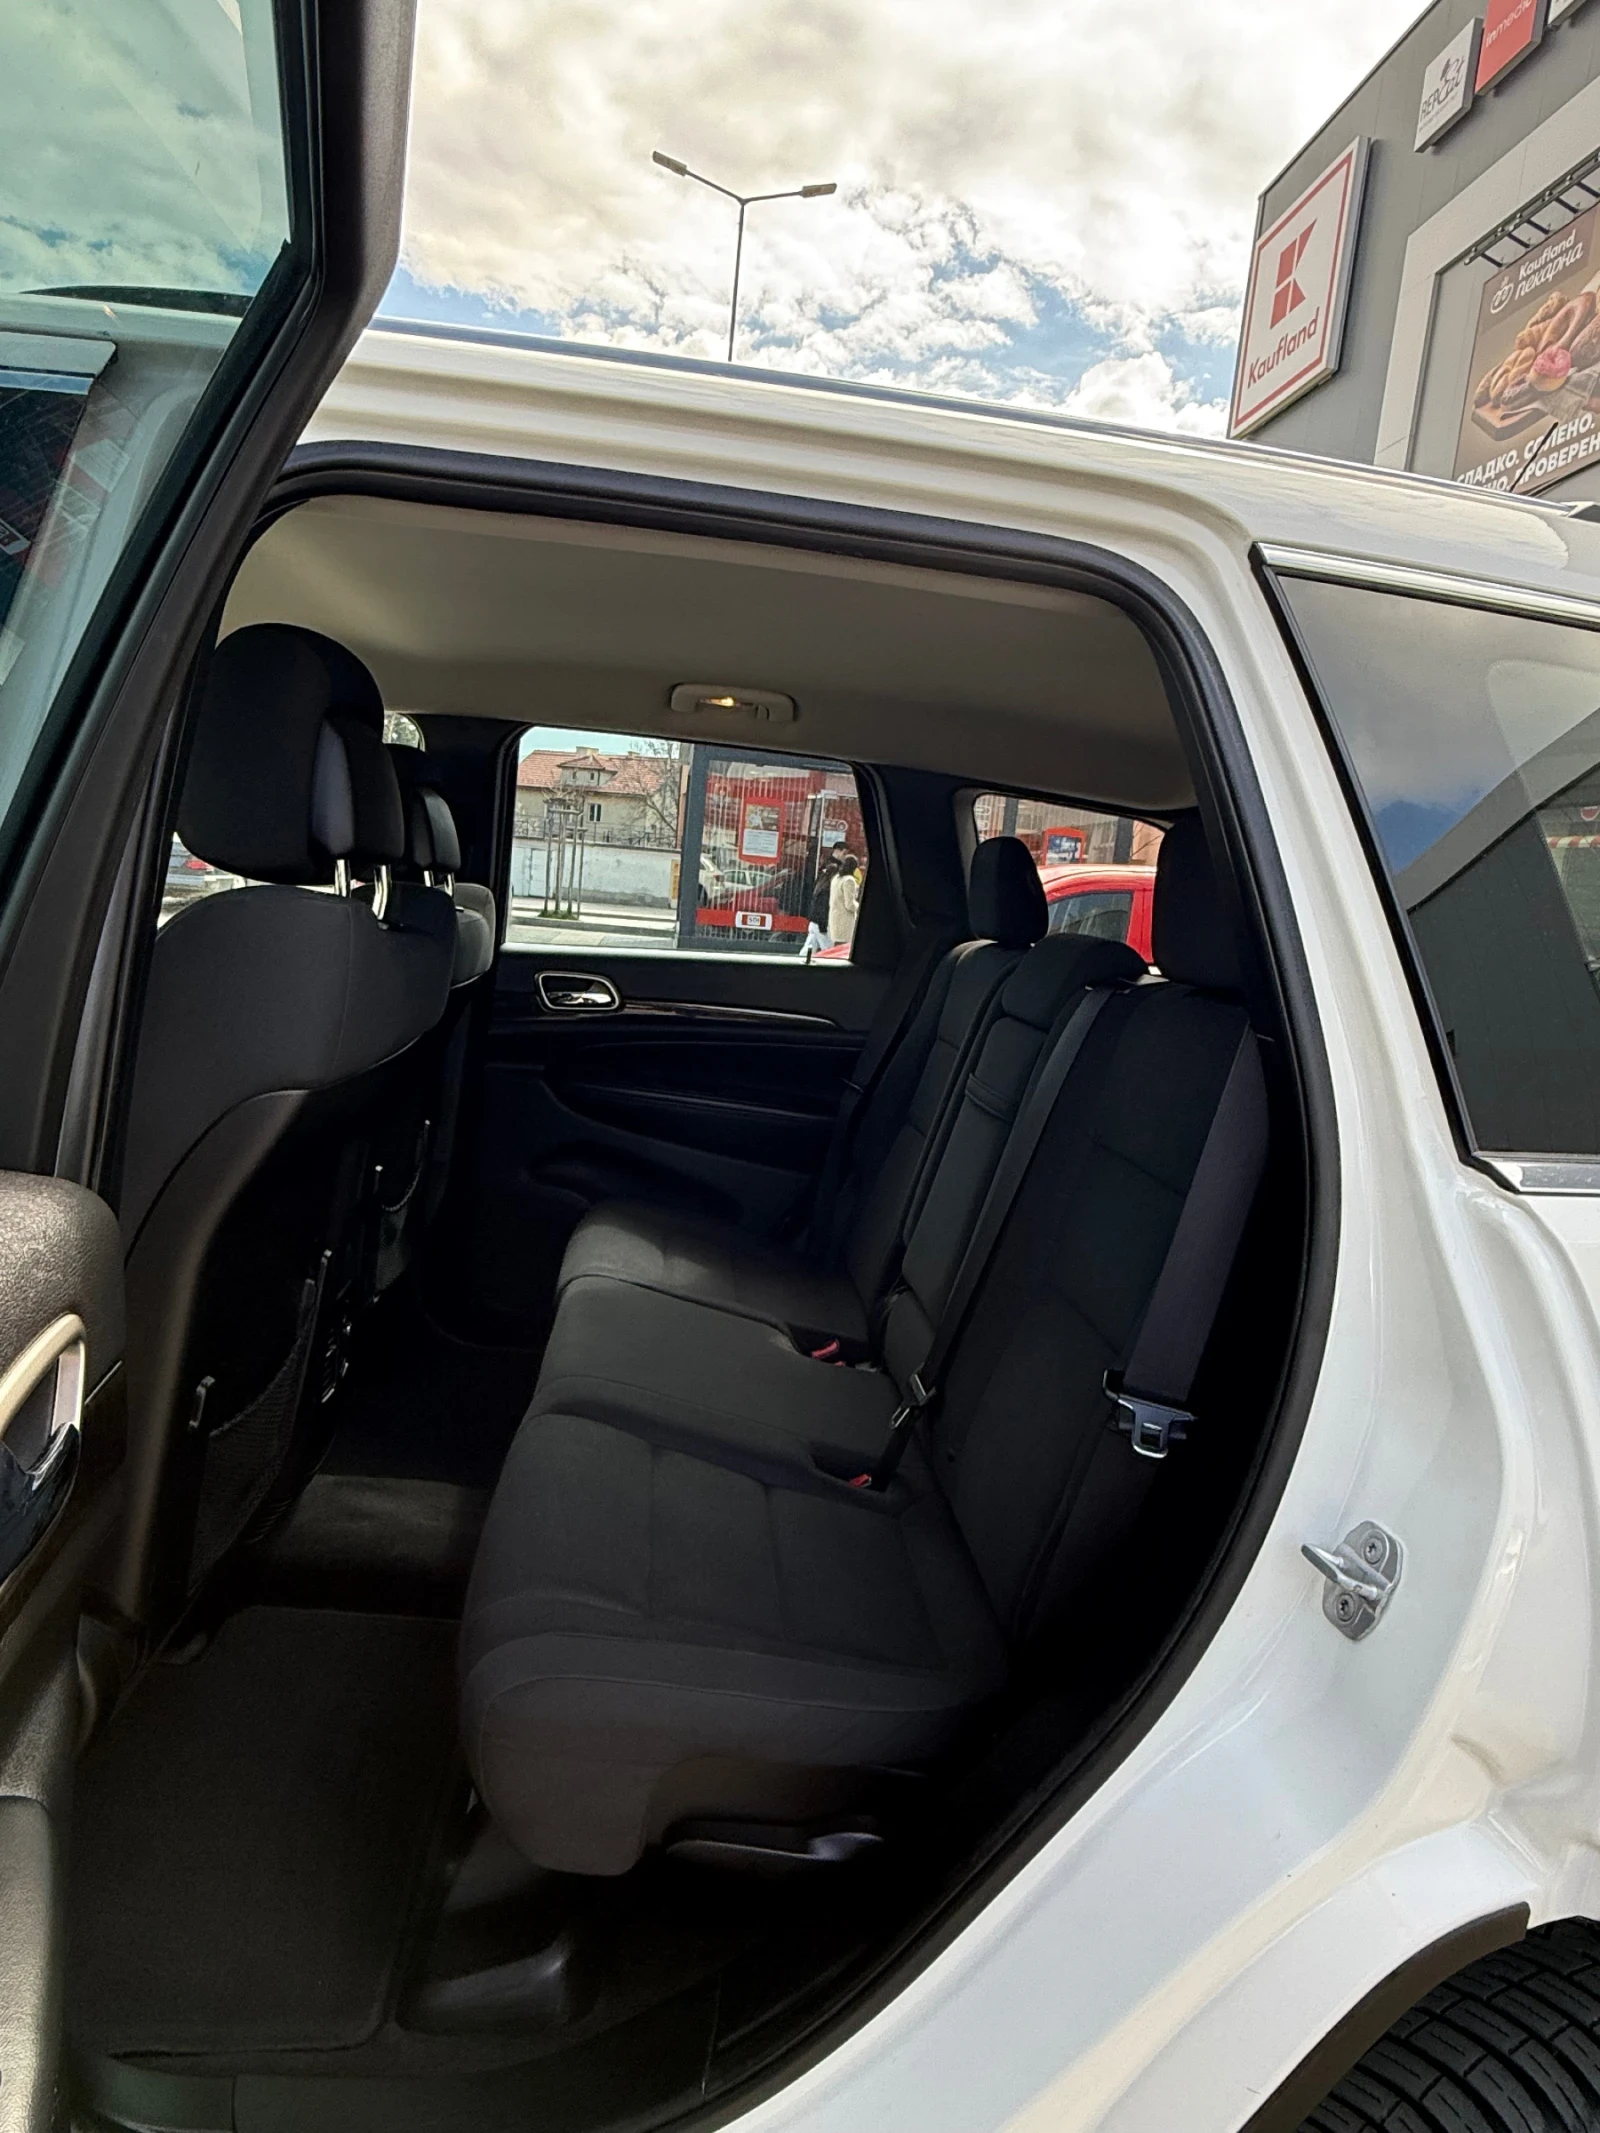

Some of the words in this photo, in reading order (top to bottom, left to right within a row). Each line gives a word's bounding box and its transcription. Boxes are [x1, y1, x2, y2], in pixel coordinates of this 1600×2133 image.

[1515, 242, 1583, 300] пекарна
[1519, 228, 1576, 281] Kaufland
[1247, 306, 1320, 389] Kaufland
